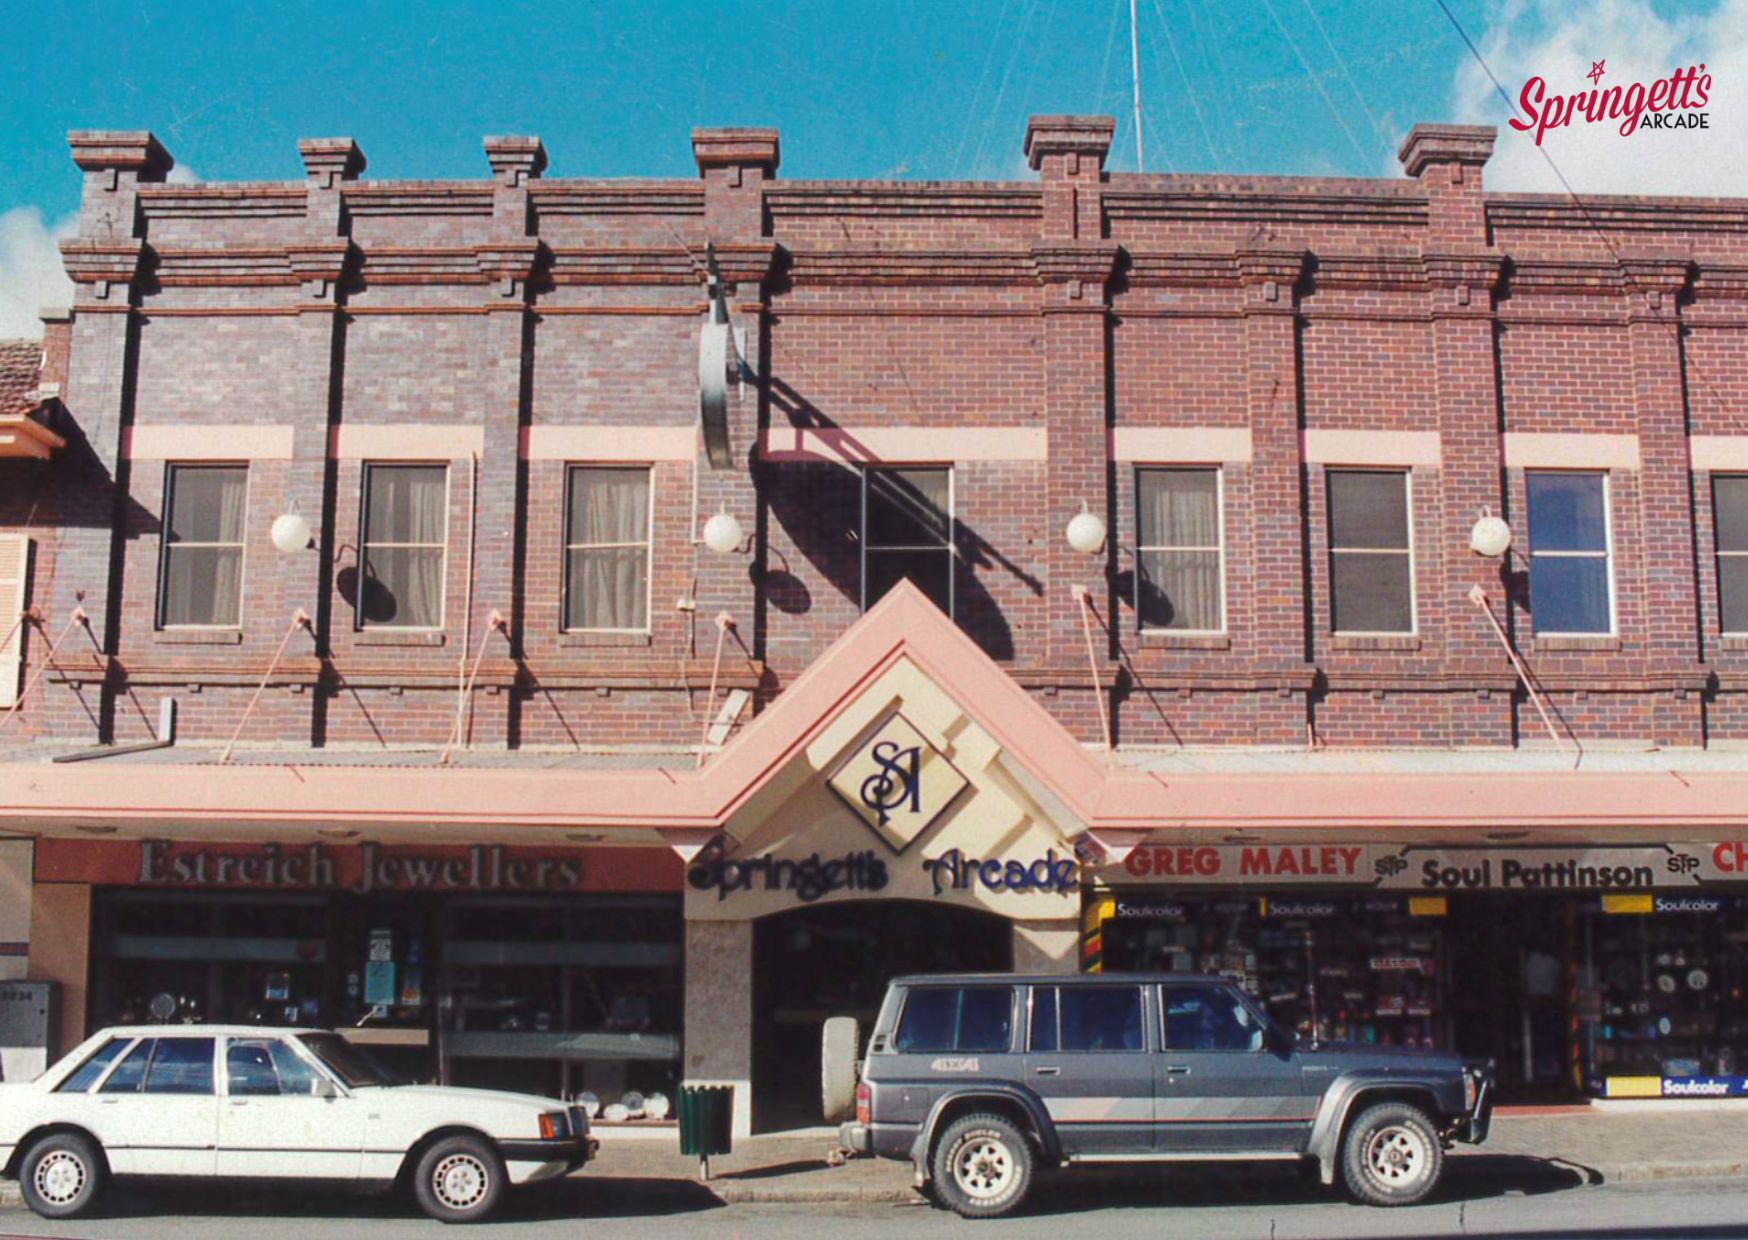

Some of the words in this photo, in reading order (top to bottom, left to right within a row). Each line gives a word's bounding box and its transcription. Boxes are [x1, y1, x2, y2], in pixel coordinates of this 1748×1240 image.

[138, 840, 335, 885] Estreich
[350, 842, 580, 893] Jewellers
[923, 848, 1078, 897] Arcade
[1125, 848, 1221, 877] GREG
[1239, 847, 1362, 876] MALEY
[1374, 855, 1408, 877] STP
[1667, 854, 1700, 874] STP
[1421, 859, 1491, 887] Soul
[1501, 859, 1654, 887] Pattinson
[1117, 903, 1183, 917] Soulcolor
[1269, 902, 1335, 915] Soulcolor
[1655, 899, 1719, 911] Soulcolor
[1663, 1079, 1729, 1095] Soulcolor
